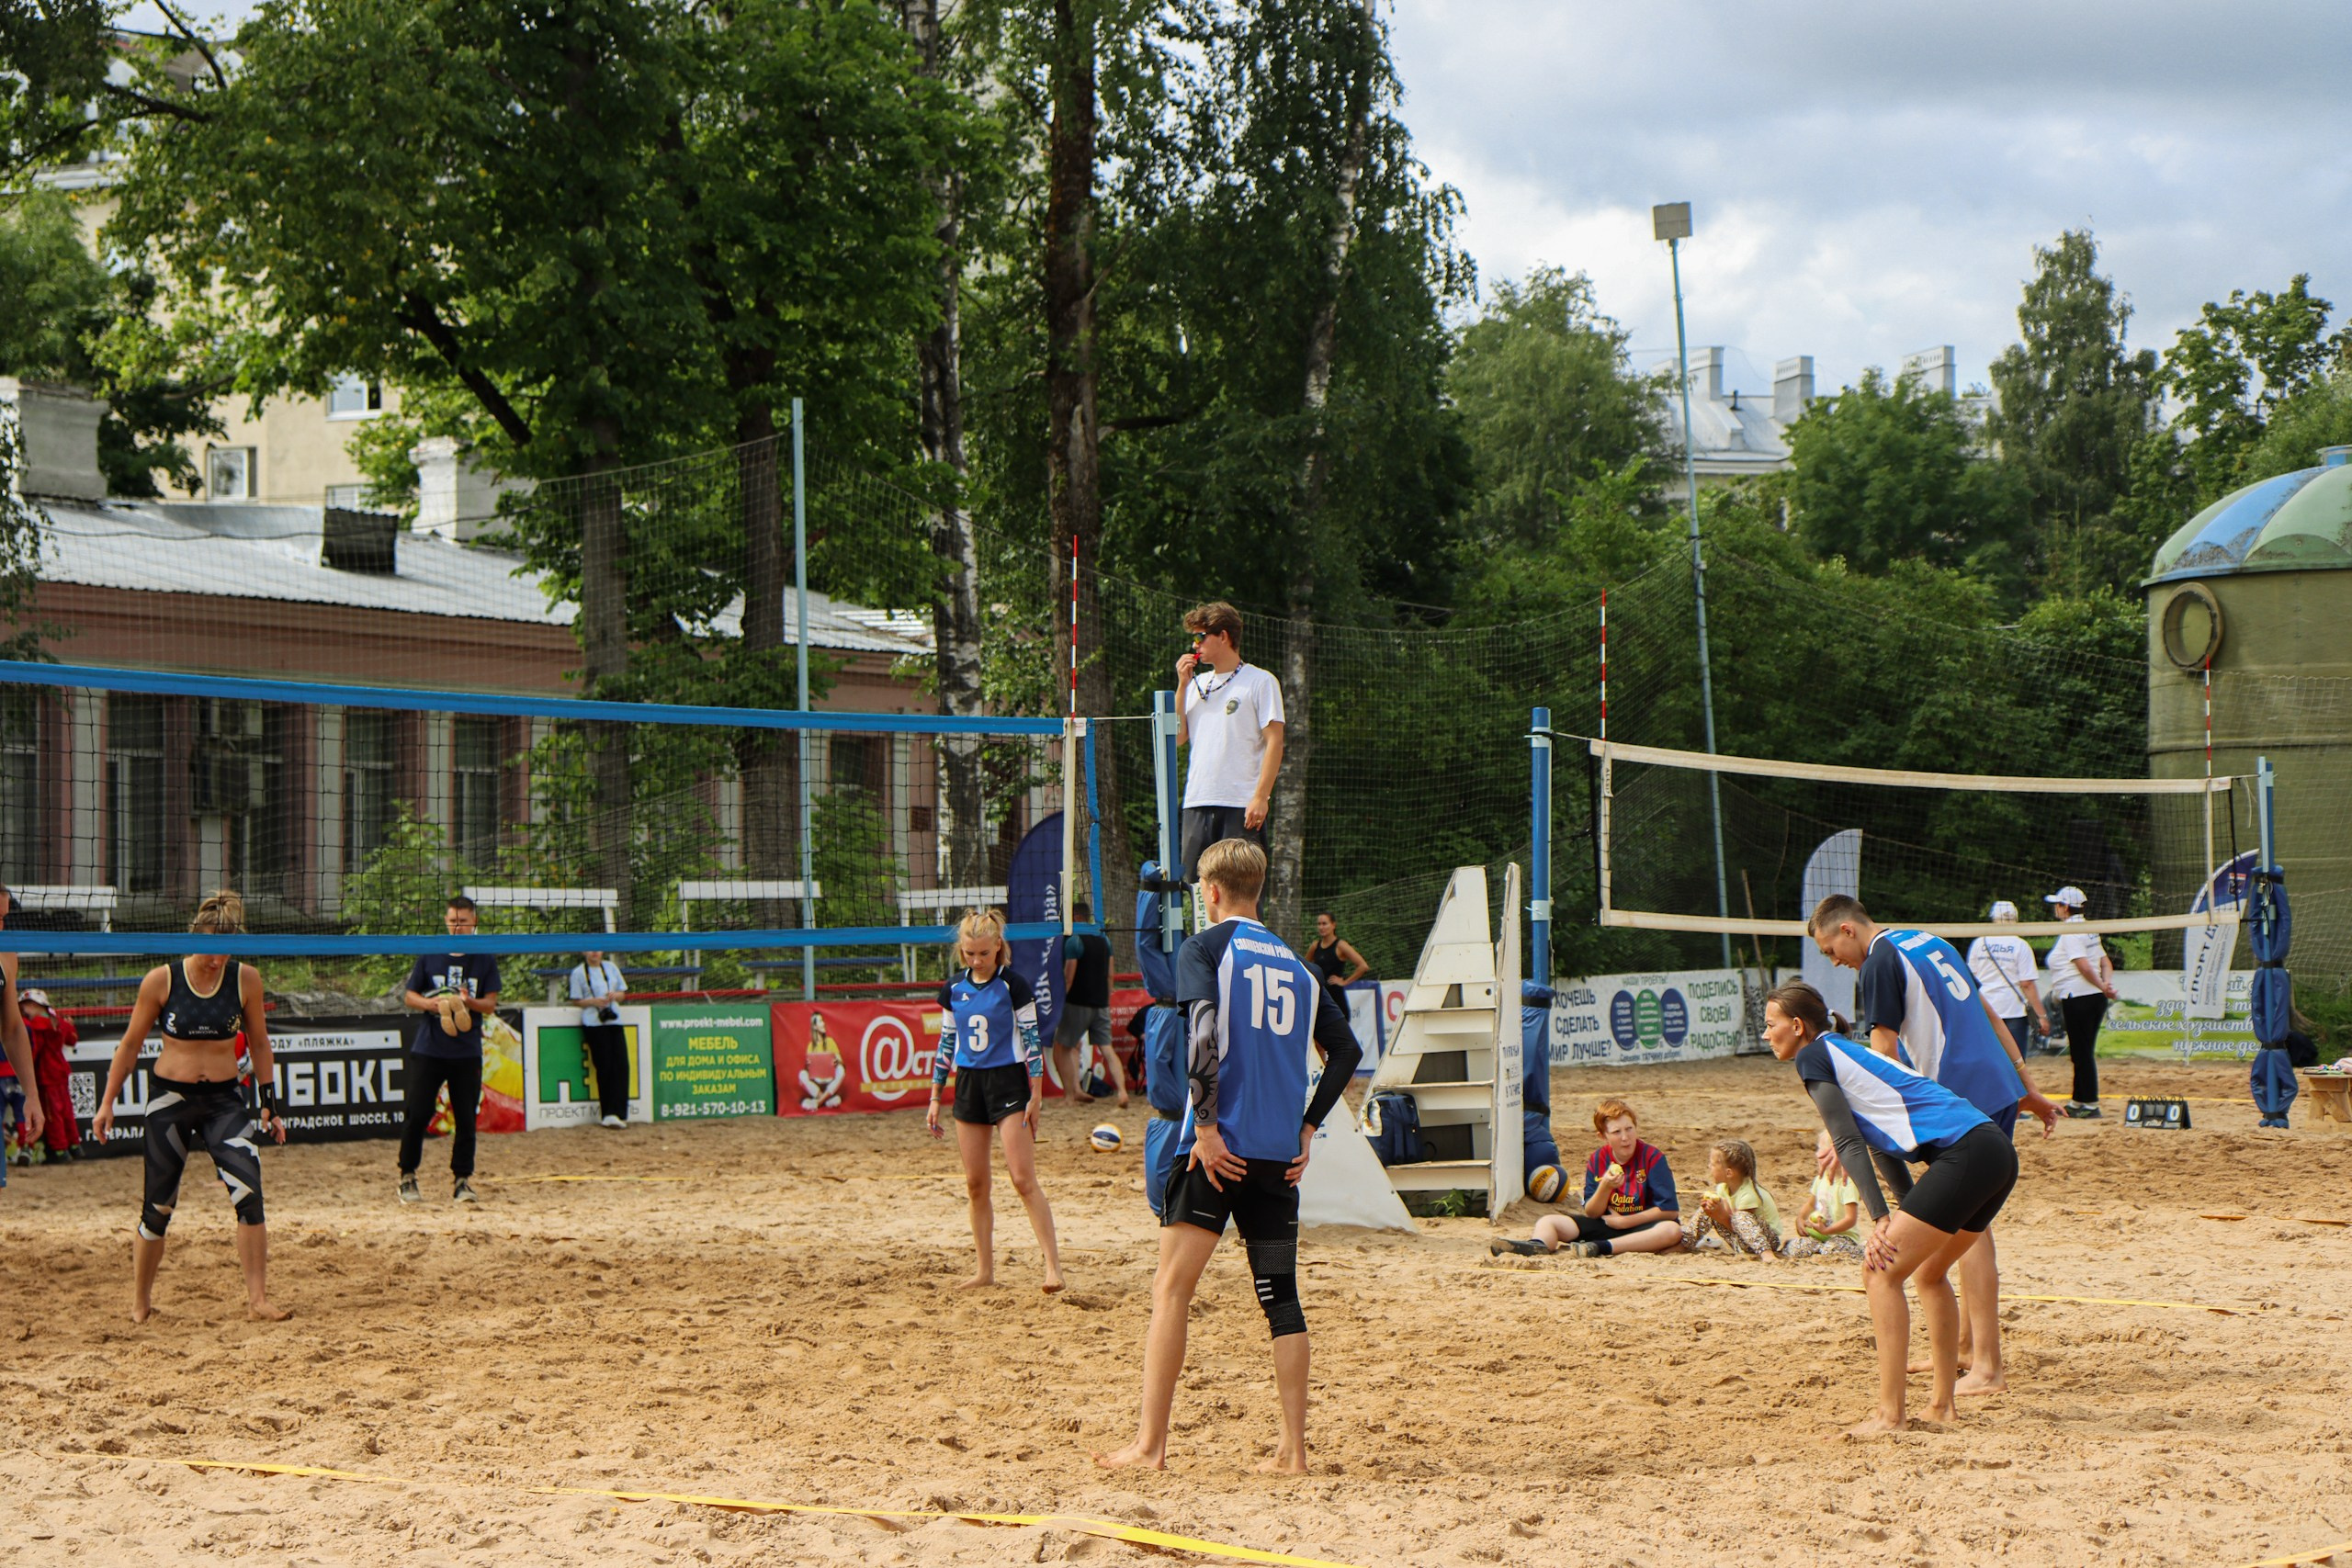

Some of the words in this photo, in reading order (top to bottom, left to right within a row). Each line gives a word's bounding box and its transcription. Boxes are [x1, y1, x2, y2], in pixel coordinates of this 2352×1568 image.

[1926, 950, 1971, 1001] 5
[2191, 942, 2211, 1005] СПОРТ
[1555, 988, 1596, 1009] ХОЧЕШЬ
[1688, 979, 1738, 1001] ПОДЕЛИСЬ
[1243, 964, 1295, 1036] 15
[1701, 1003, 1732, 1023] СВОЕЙ
[660, 1017, 763, 1030] www.proekt-mebel.com
[1556, 1015, 1600, 1038] СДЕЛАТЬ
[2107, 1019, 2177, 1032] сельское
[2177, 1016, 2255, 1036] хозяйств
[968, 1014, 989, 1052] 3
[299, 1036, 355, 1048] «ПЛЯЖКА»
[688, 1036, 739, 1050] МЕБЕЛЬ
[1549, 1043, 1568, 1062] МИР
[1572, 1039, 1612, 1060] ЛУЧШЕ?
[2174, 1040, 2233, 1056] нужное
[666, 1056, 685, 1067] ДЛЯ
[688, 1055, 716, 1067] ДОМА
[718, 1055, 724, 1065] И
[726, 1054, 760, 1065] ОФИСА
[660, 1071, 674, 1082] ПО
[676, 1068, 767, 1081] ИНДИВИДУАЛЬНЫМ
[692, 1083, 736, 1095] ЗАКАЗАМ
[539, 1106, 587, 1119] ПРОЕКТ
[662, 1100, 766, 1117] 8-921-570-10-13
[2129, 1104, 2140, 1121] 0
[2169, 1105, 2181, 1121] 0
[349, 1112, 391, 1125] ШОССЕ,
[393, 1111, 405, 1123] 10
[1611, 1192, 1634, 1205] Qatar
